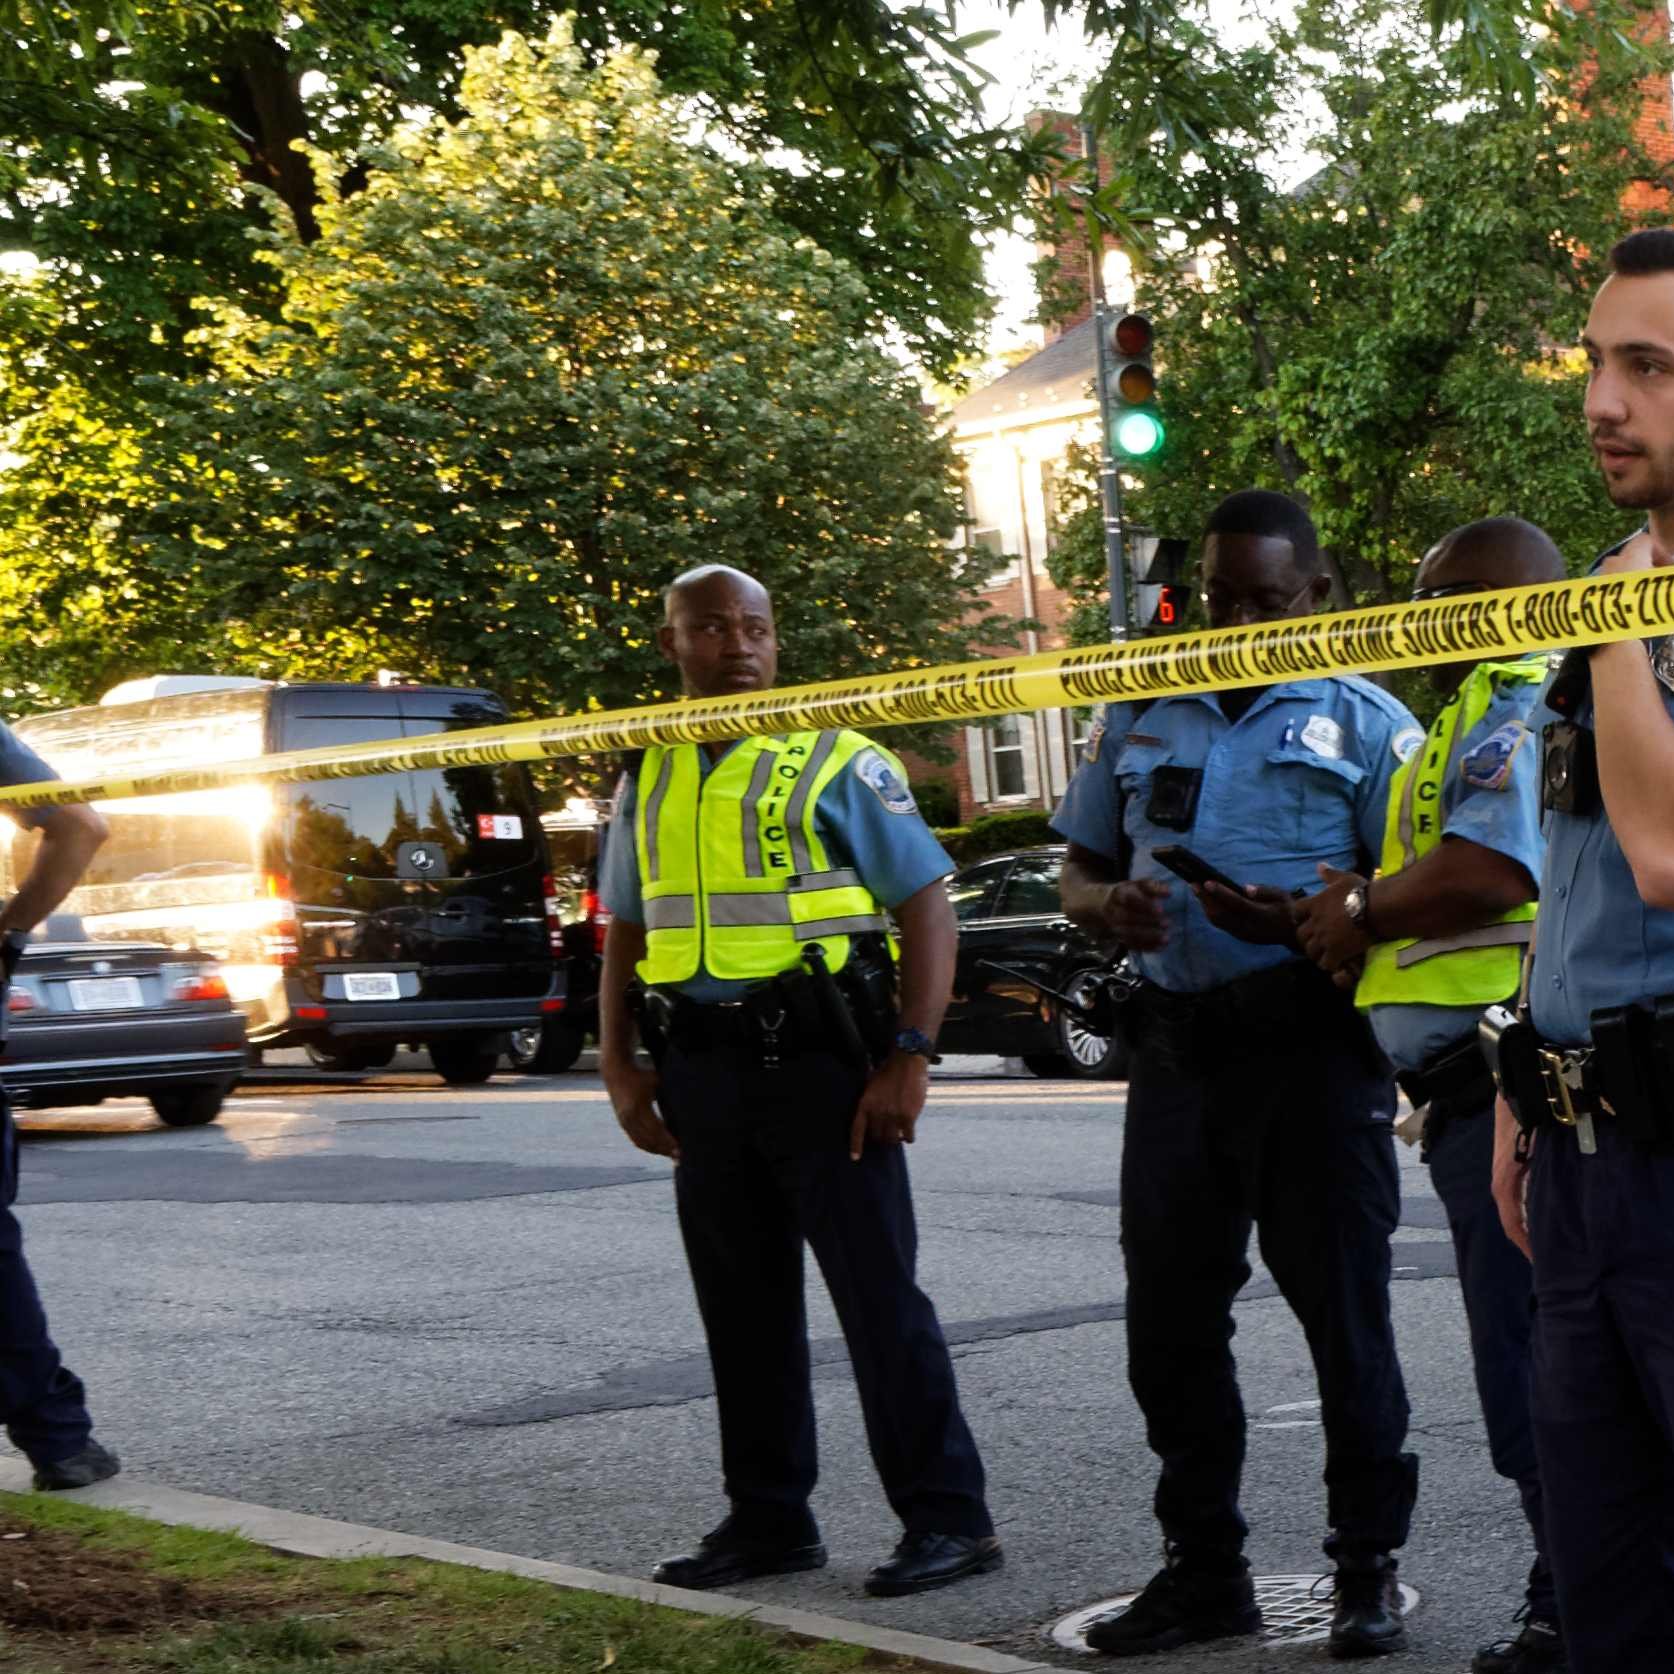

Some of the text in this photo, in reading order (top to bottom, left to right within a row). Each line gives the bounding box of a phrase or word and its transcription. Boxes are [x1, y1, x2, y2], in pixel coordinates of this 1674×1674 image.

[1059, 649, 1136, 699] POLICE
[1131, 643, 1180, 692] LINE
[1175, 638, 1211, 685] DO
[1207, 632, 1255, 681] NOT
[1252, 622, 1329, 676] CROSS
[1328, 610, 1405, 674] CRIME
[1402, 596, 1506, 658] SOLVERS
[1159, 584, 1176, 624] 6
[763, 745, 806, 868] POLICE
